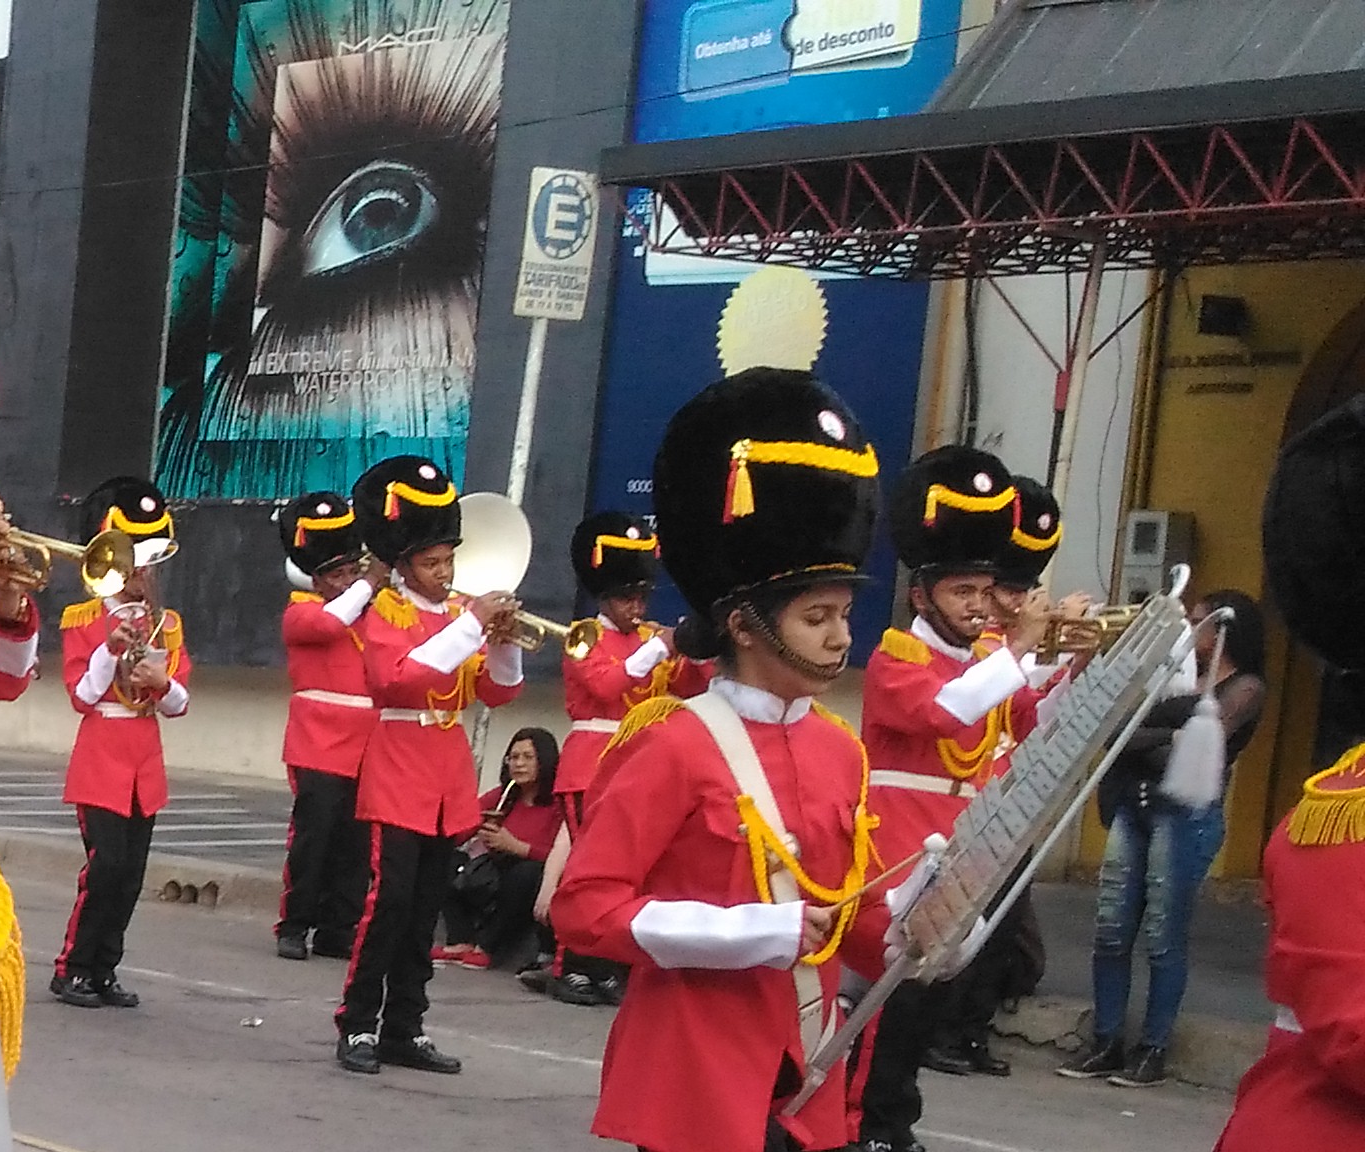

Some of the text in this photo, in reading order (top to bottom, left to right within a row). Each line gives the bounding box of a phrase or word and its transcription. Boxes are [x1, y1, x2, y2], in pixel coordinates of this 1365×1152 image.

[338, 26, 441, 58] MAC
[694, 29, 773, 60] Obtenha até
[795, 21, 896, 57] de desconto
[545, 192, 581, 241] E
[523, 271, 580, 290] TARIFADO
[265, 350, 353, 375] EXTREME
[293, 367, 423, 396] WATERPROOF
